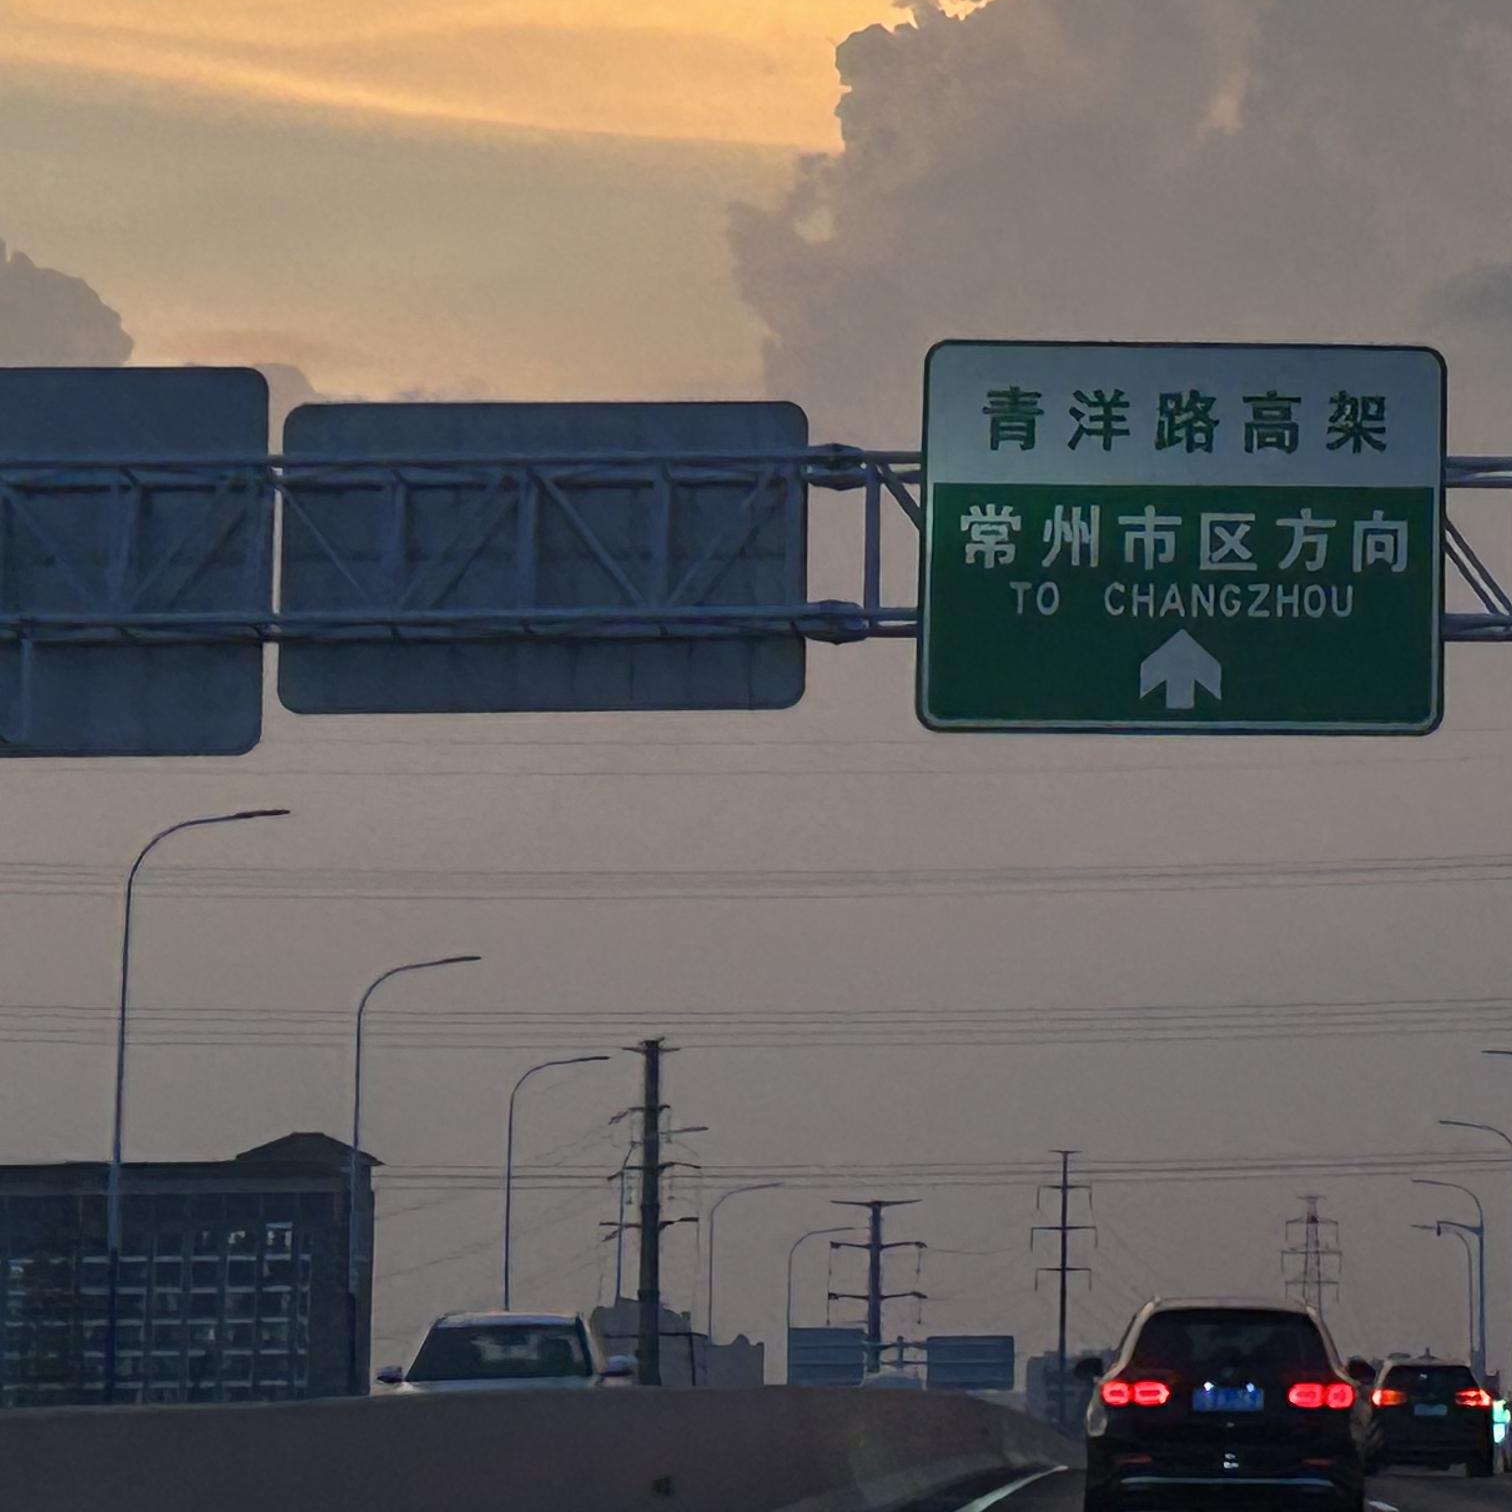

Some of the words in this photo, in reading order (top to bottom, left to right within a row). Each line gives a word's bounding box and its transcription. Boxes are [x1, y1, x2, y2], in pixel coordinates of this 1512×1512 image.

[982, 386, 1387, 454] 青洋路高架
[960, 504, 1408, 572] 常州市区方向
[1009, 582, 1060, 617] TO
[1104, 583, 1354, 619] CHANGZHOU
